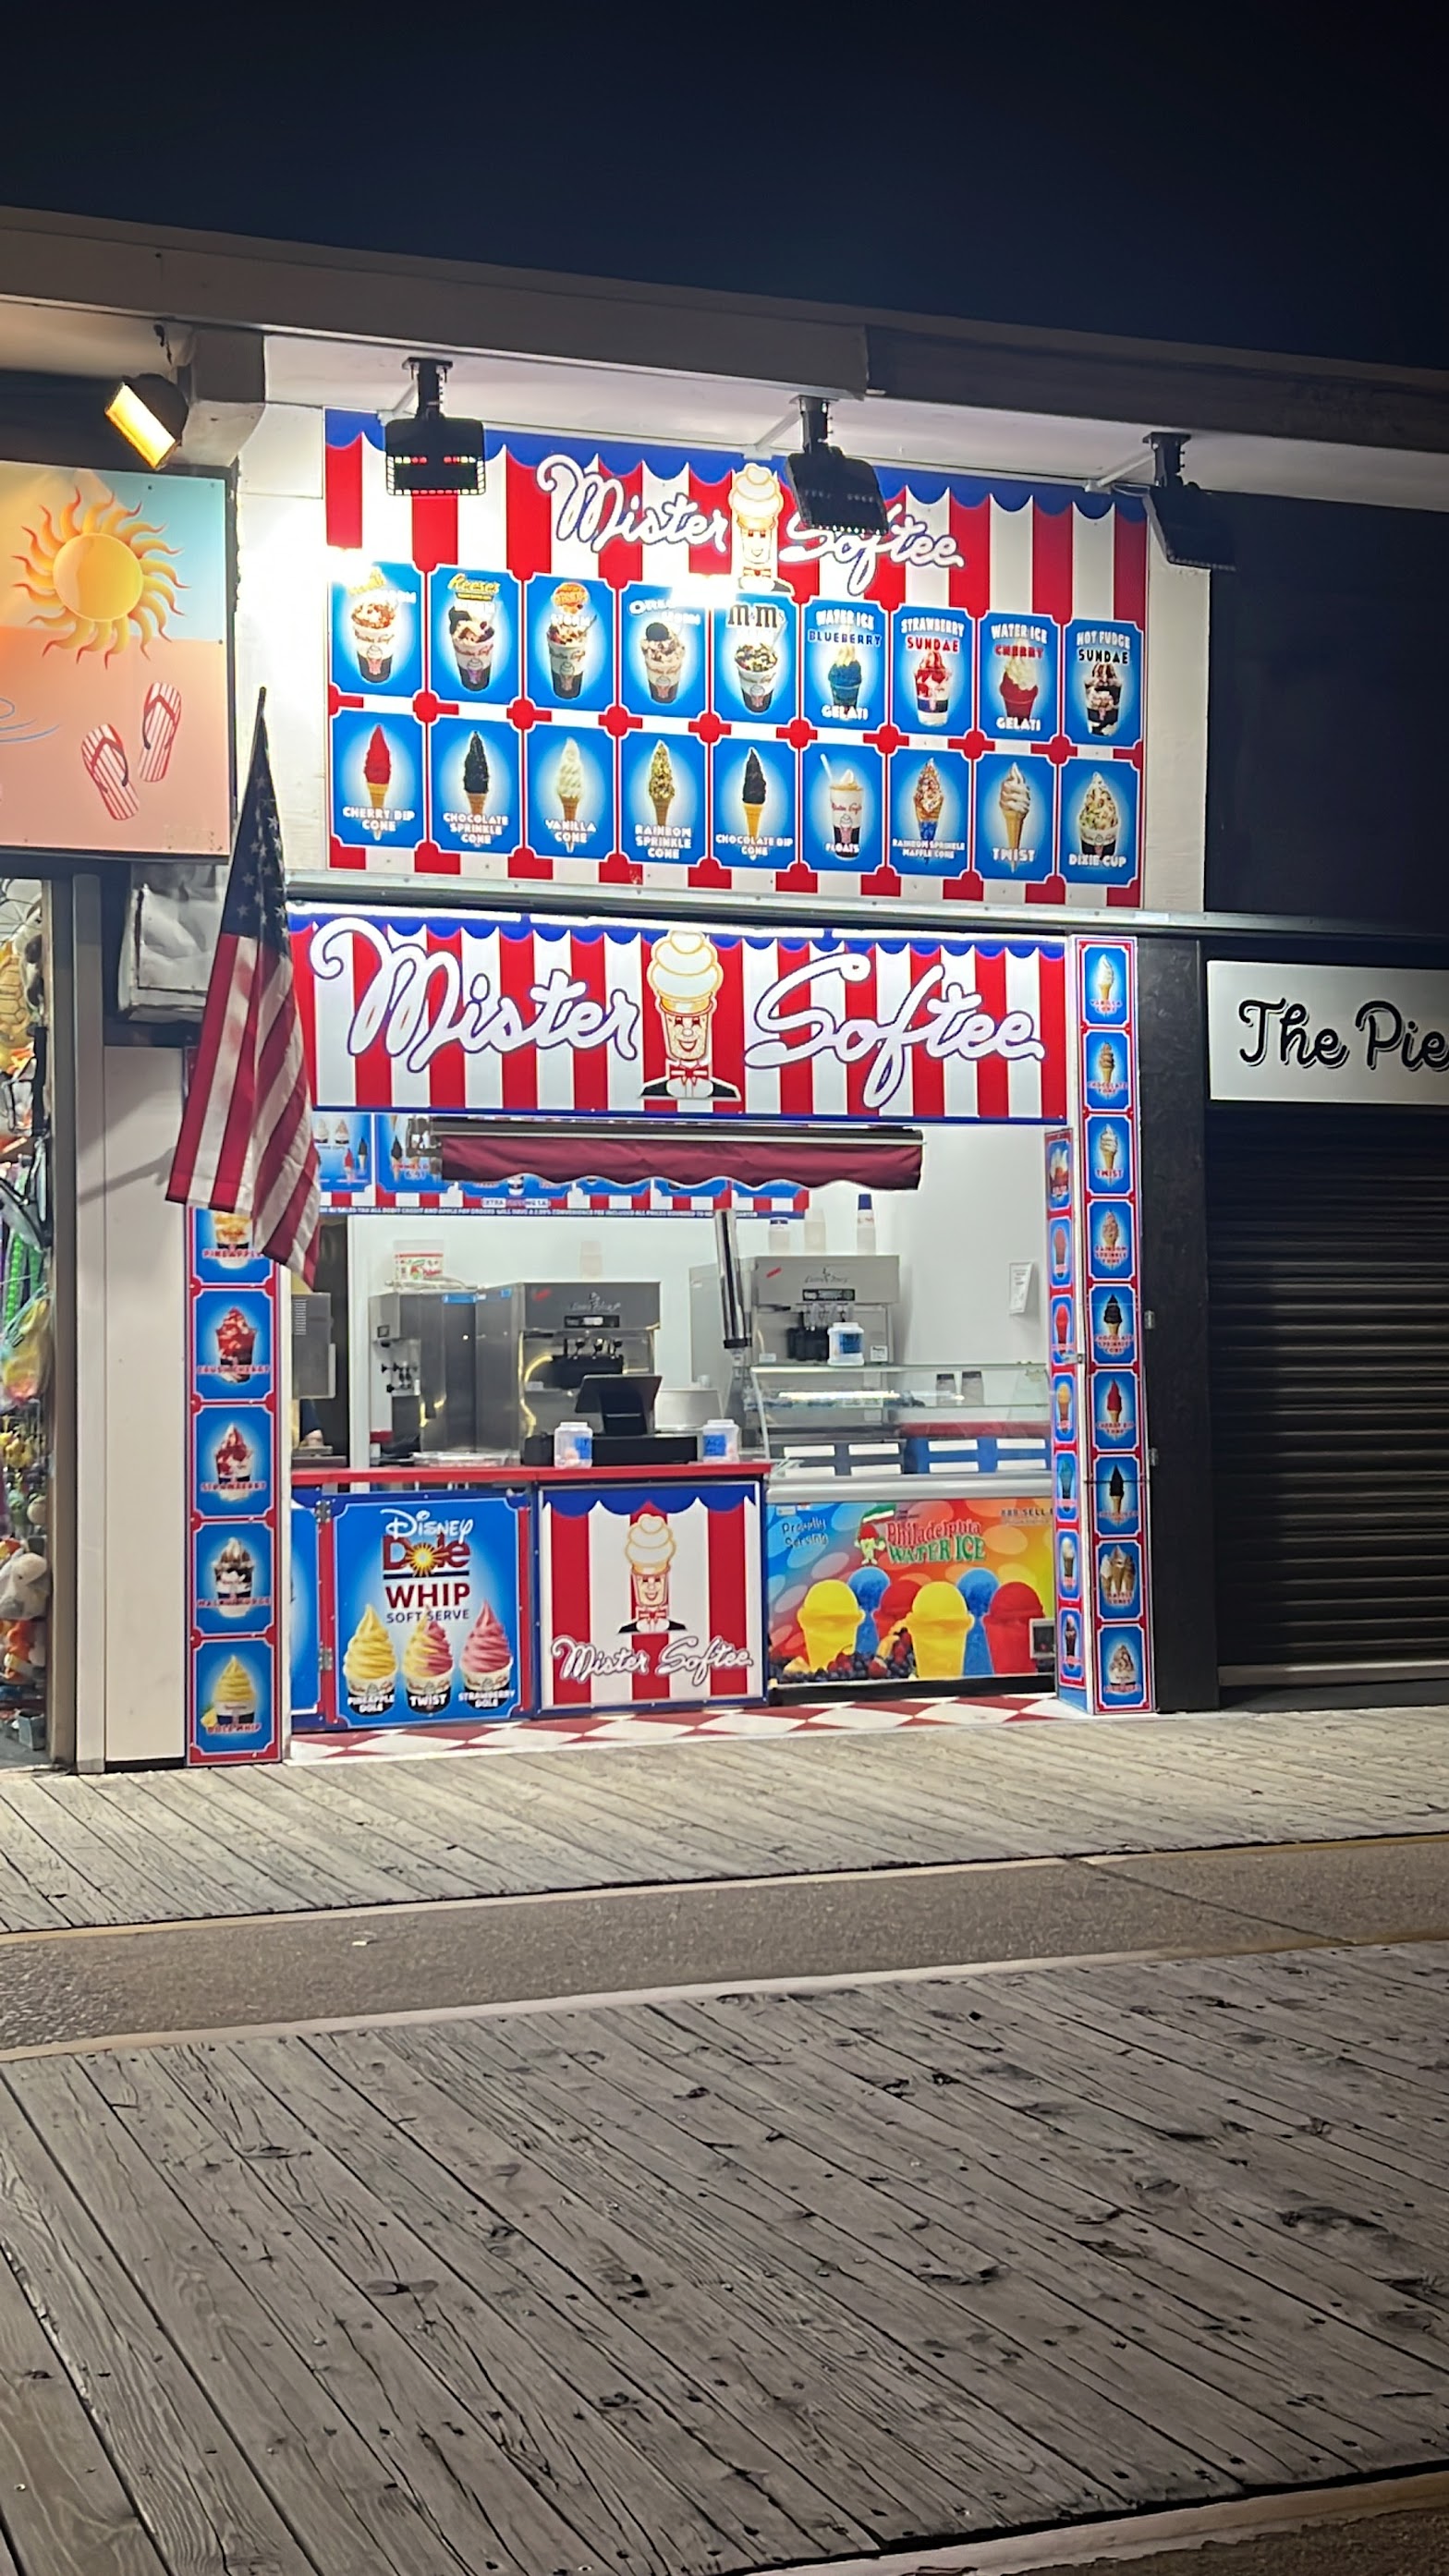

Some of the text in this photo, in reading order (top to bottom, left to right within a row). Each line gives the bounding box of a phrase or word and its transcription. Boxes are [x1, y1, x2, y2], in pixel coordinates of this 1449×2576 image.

[536, 454, 728, 553] Mister
[816, 609, 874, 631] WATER ICE
[901, 617, 965, 638] STRAWBERRY
[992, 624, 1048, 644] WATER ICE
[809, 629, 882, 646] BLUEBERRY
[907, 637, 959, 652] SUNDAE
[1077, 632, 1131, 650] HOT FUDGE
[994, 645, 1044, 659] CHERRY
[1078, 650, 1128, 664] SUNDAE
[822, 705, 869, 720] GELATI
[996, 717, 1041, 731] GELATI
[343, 806, 415, 821] CHERRY DIP
[444, 812, 509, 826] CHOCOLATE
[362, 819, 396, 832] CONE
[449, 822, 502, 836] SPRINKLE
[545, 820, 596, 832] VANILLA
[635, 824, 691, 837] RAINBOW
[460, 832, 492, 844] CONE
[554, 831, 588, 844] CONE
[635, 835, 692, 849] SPRINKLE
[715, 833, 794, 847] CHOCOLATE DIP
[893, 838, 966, 851] RAINBOW SPRINKLE
[648, 847, 680, 859] CONE
[741, 845, 768, 857] CONE
[825, 842, 859, 853] FLOATS
[903, 848, 955, 859] WAFFLE CONE
[992, 847, 1035, 862] TWIST
[1068, 853, 1126, 868] DIXIE CUP
[309, 917, 1045, 1109] Mister Softee
[1238, 998, 1350, 1069] The
[1095, 1169, 1123, 1177] TWIST
[782, 1516, 827, 1535] Proudly
[785, 1532, 829, 1549] Serving
[886, 1518, 981, 1549] Philadelphia
[888, 1534, 986, 1563] WATER ICE
[385, 1584, 469, 1609] WHIP
[386, 1609, 469, 1623] SOFT SERVE
[552, 1634, 754, 1686] Mister Softee
[347, 1695, 395, 1706] PINEAPPLE
[409, 1694, 446, 1707] TWIST
[458, 1690, 515, 1701] STRAWBERRY
